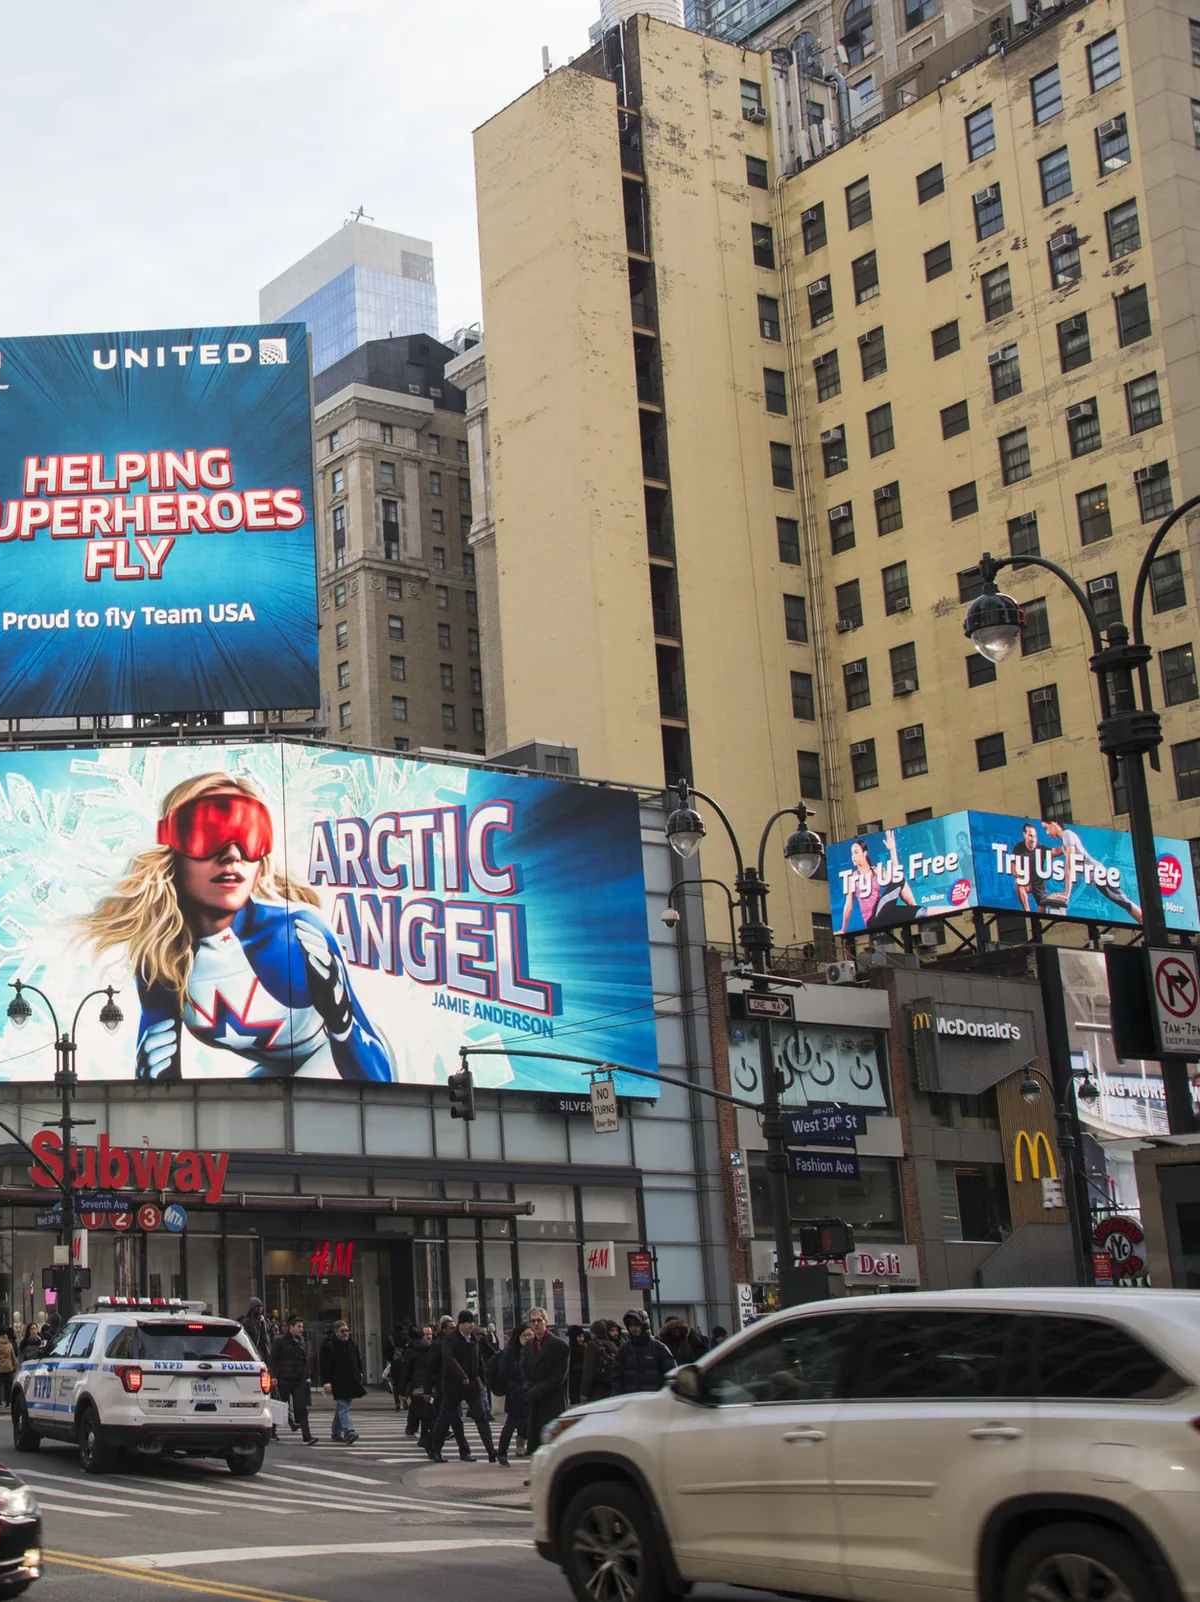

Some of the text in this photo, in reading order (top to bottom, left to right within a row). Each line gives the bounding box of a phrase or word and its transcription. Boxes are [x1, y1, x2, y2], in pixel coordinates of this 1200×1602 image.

[93, 343, 252, 369] UNITED
[23, 447, 232, 496] HELPING
[84, 537, 174, 581] FLY
[2, 603, 255, 630] Proud to fly Team USA
[307, 799, 523, 896] ARCTIC
[839, 851, 959, 898] Try Us Free
[991, 843, 1121, 888] Try Us Free
[1158, 861, 1182, 884] 24
[952, 883, 971, 896] 24
[330, 892, 563, 1017] ANGEL
[431, 992, 554, 1039] JAMIE ANDERSON
[753, 1000, 786, 1011] ONE WAY
[936, 1017, 1021, 1040] McDonald's
[596, 1088, 609, 1100] NO
[560, 1100, 593, 1112] SILVER
[593, 1103, 615, 1116] TURNS
[792, 1115, 858, 1133] West 34th St
[29, 1130, 230, 1204] Subway
[795, 1157, 855, 1174] Fashion Ave
[81, 1199, 129, 1210] Seventh Ave
[36, 1217, 48, 1225] West
[114, 1211, 127, 1226] 2
[143, 1208, 156, 1227] 3
[163, 1206, 183, 1227] MTA
[308, 1240, 355, 1278] H&M
[587, 1248, 609, 1270] H&M
[858, 1252, 902, 1275] Deli
[154, 1361, 255, 1371] NYPD POLICE
[33, 1375, 52, 1399] NYPD
[193, 1384, 211, 1393] 4050
